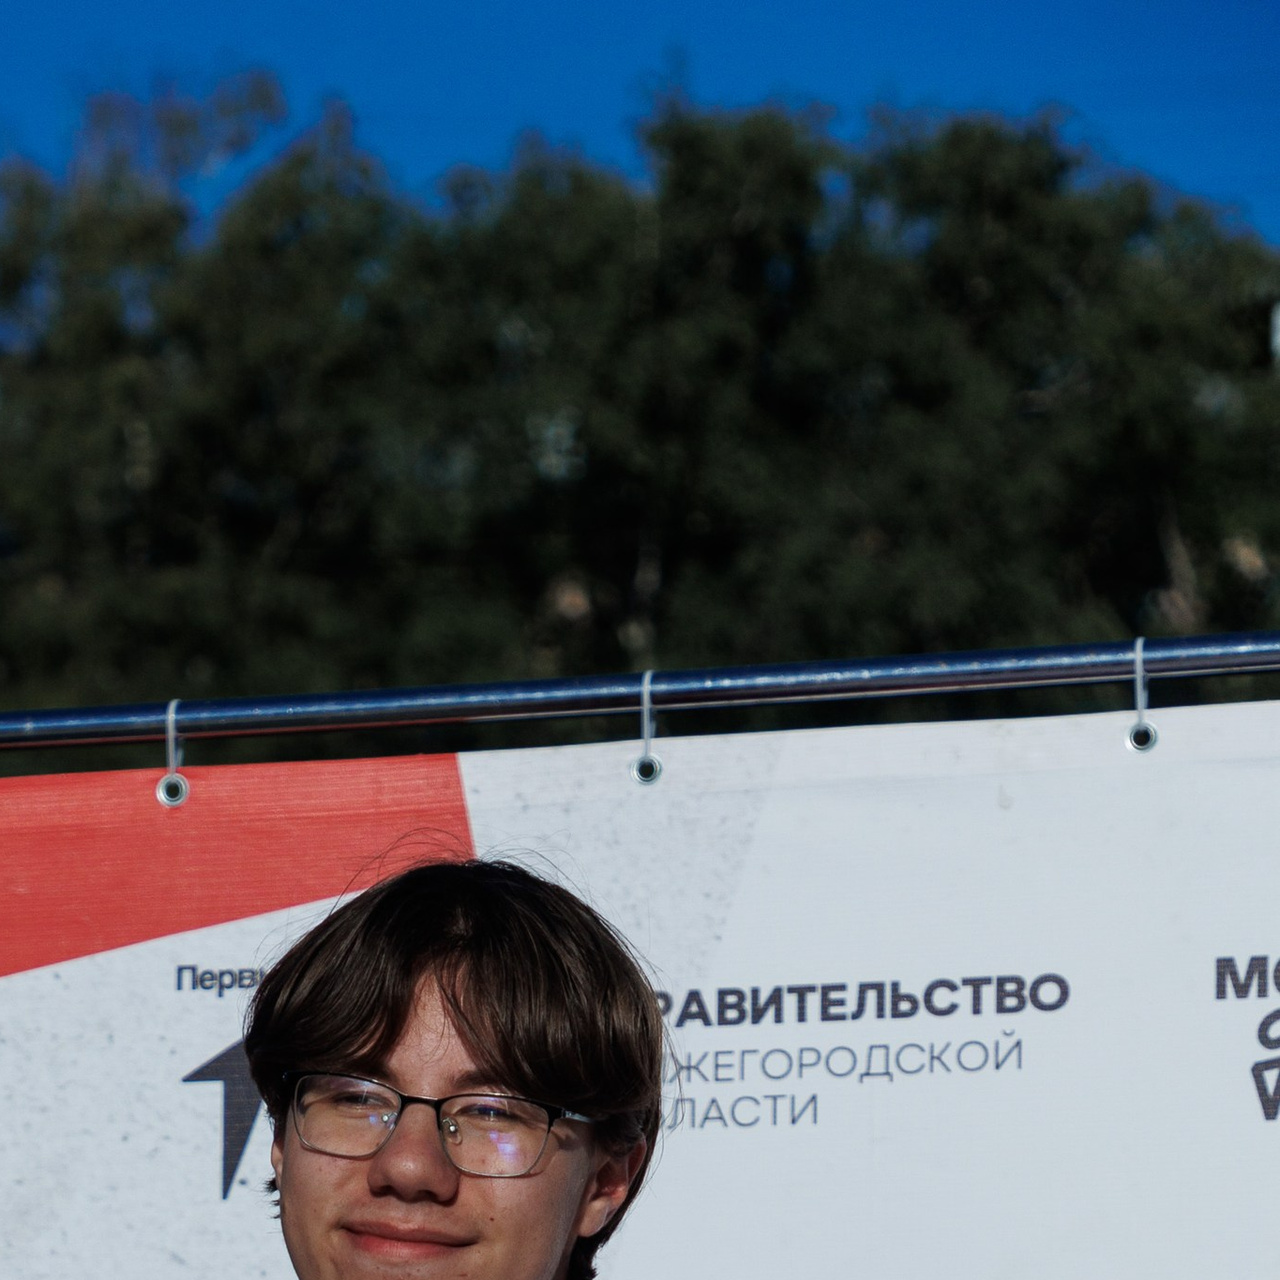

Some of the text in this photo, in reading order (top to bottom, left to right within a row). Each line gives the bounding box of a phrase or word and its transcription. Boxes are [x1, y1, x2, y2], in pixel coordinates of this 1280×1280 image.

[176, 964, 265, 998] Перв
[1215, 955, 1280, 1000] М
[661, 1029, 1023, 1085] ЖЕГОРОДСКОЙ
[660, 1093, 819, 1131] ЛАСТИ
